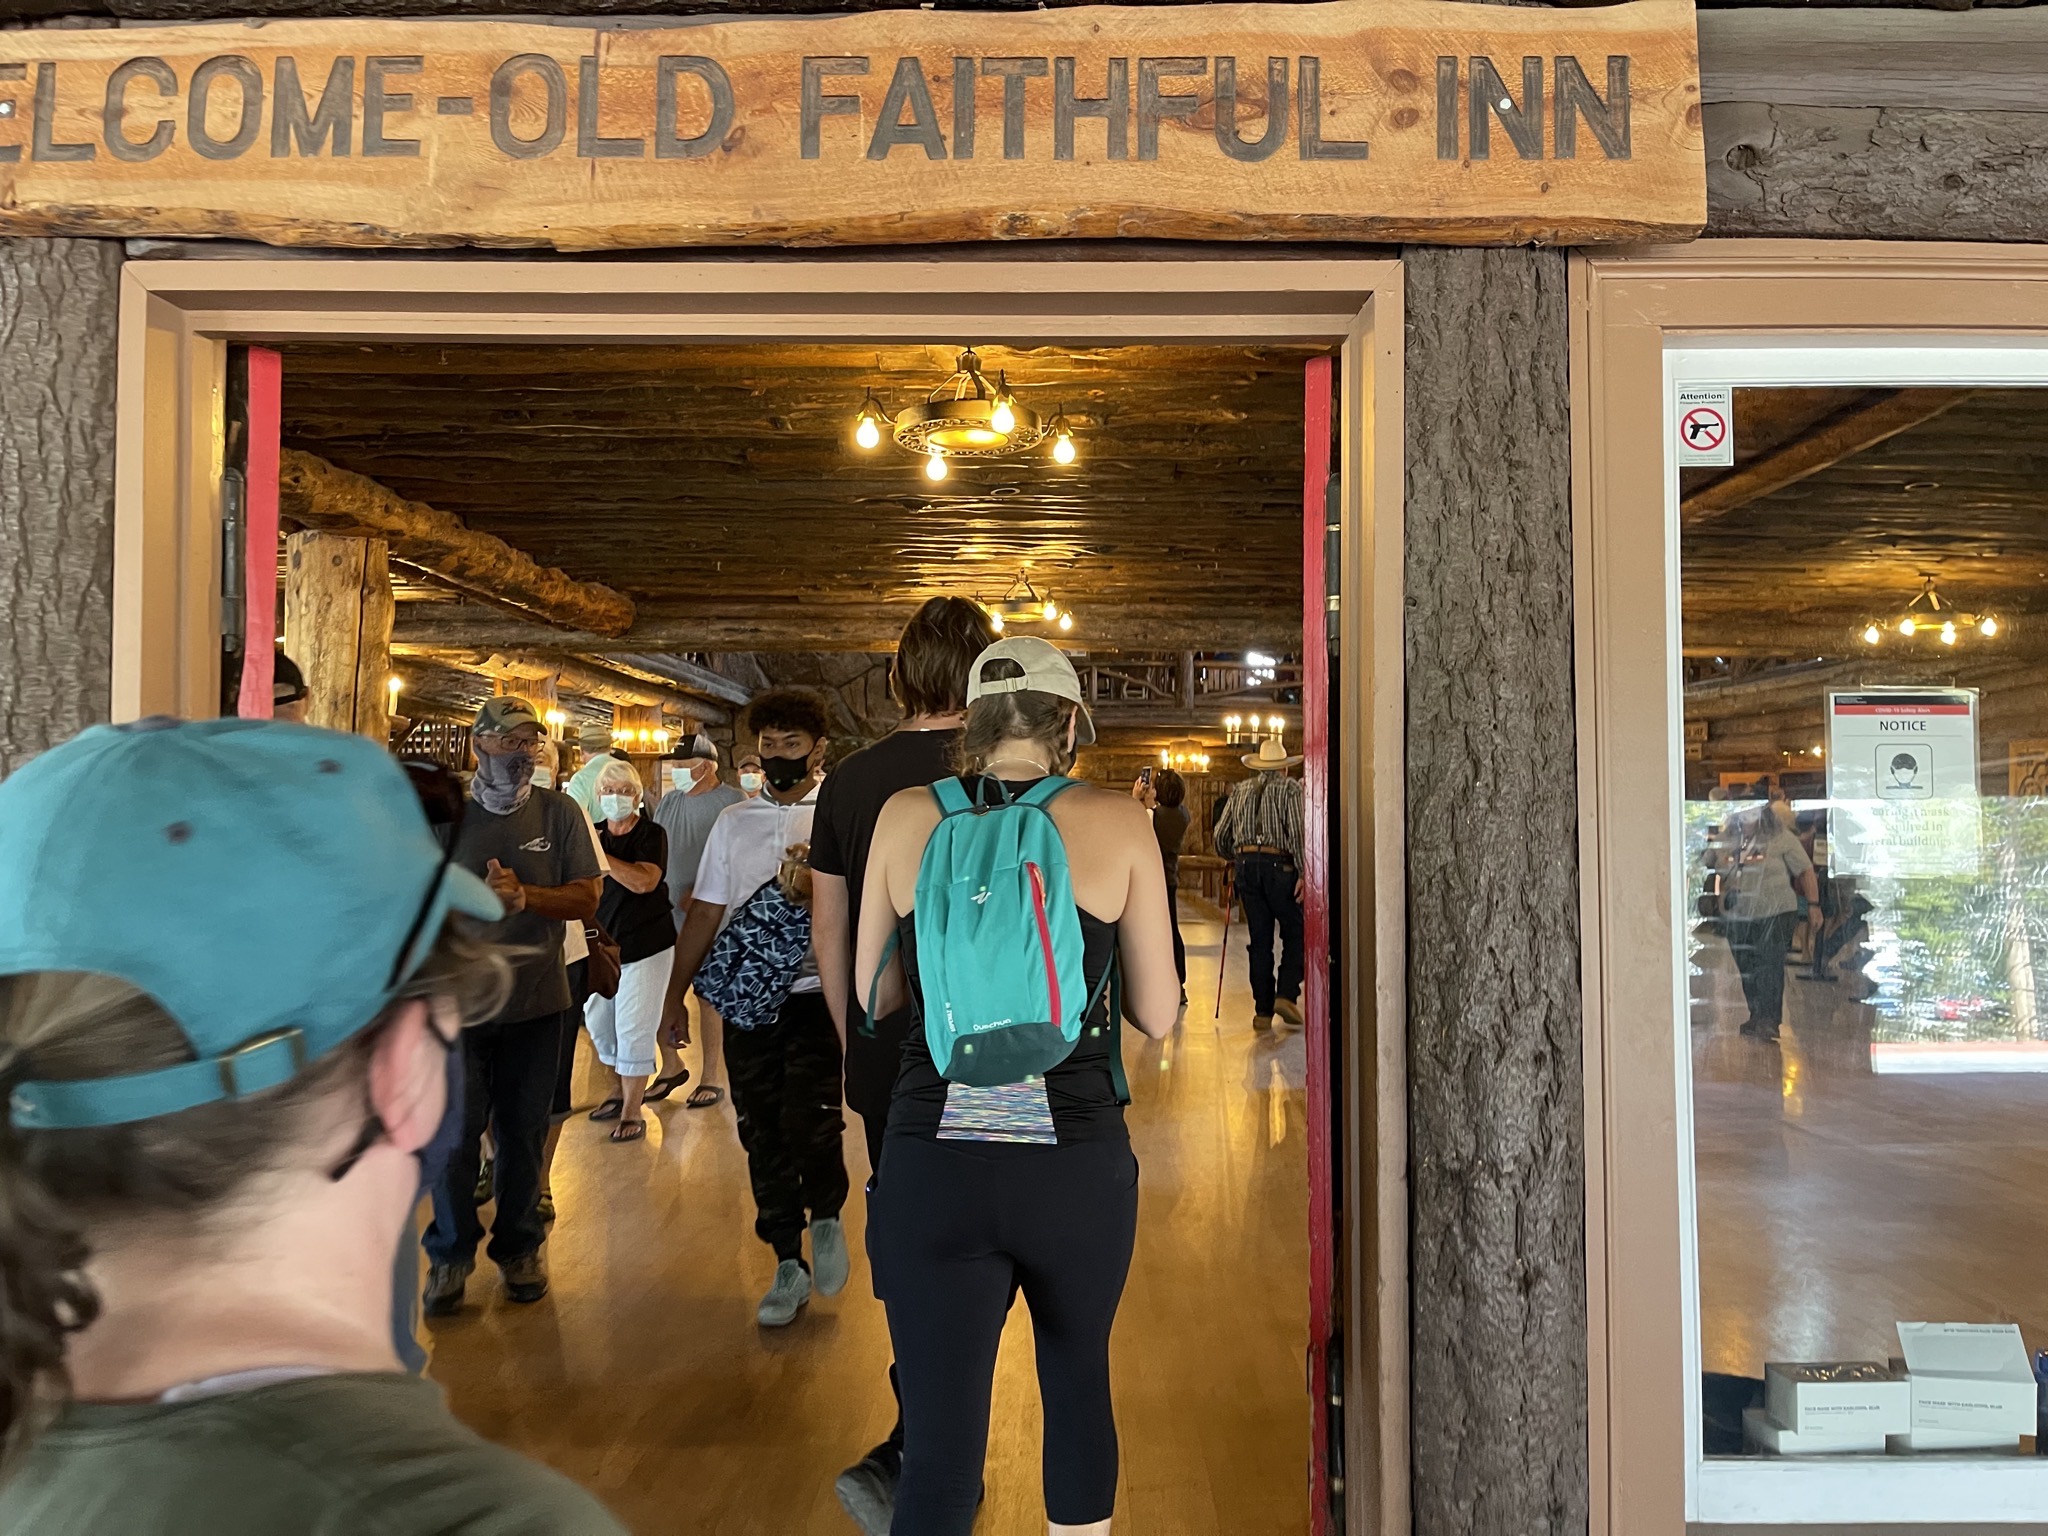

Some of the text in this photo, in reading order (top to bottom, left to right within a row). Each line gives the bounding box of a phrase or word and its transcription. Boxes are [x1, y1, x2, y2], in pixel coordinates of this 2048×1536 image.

[800, 55, 1368, 162] FAITHFUL
[1436, 55, 1633, 162] INN
[1880, 721, 1926, 731] NOTICE
